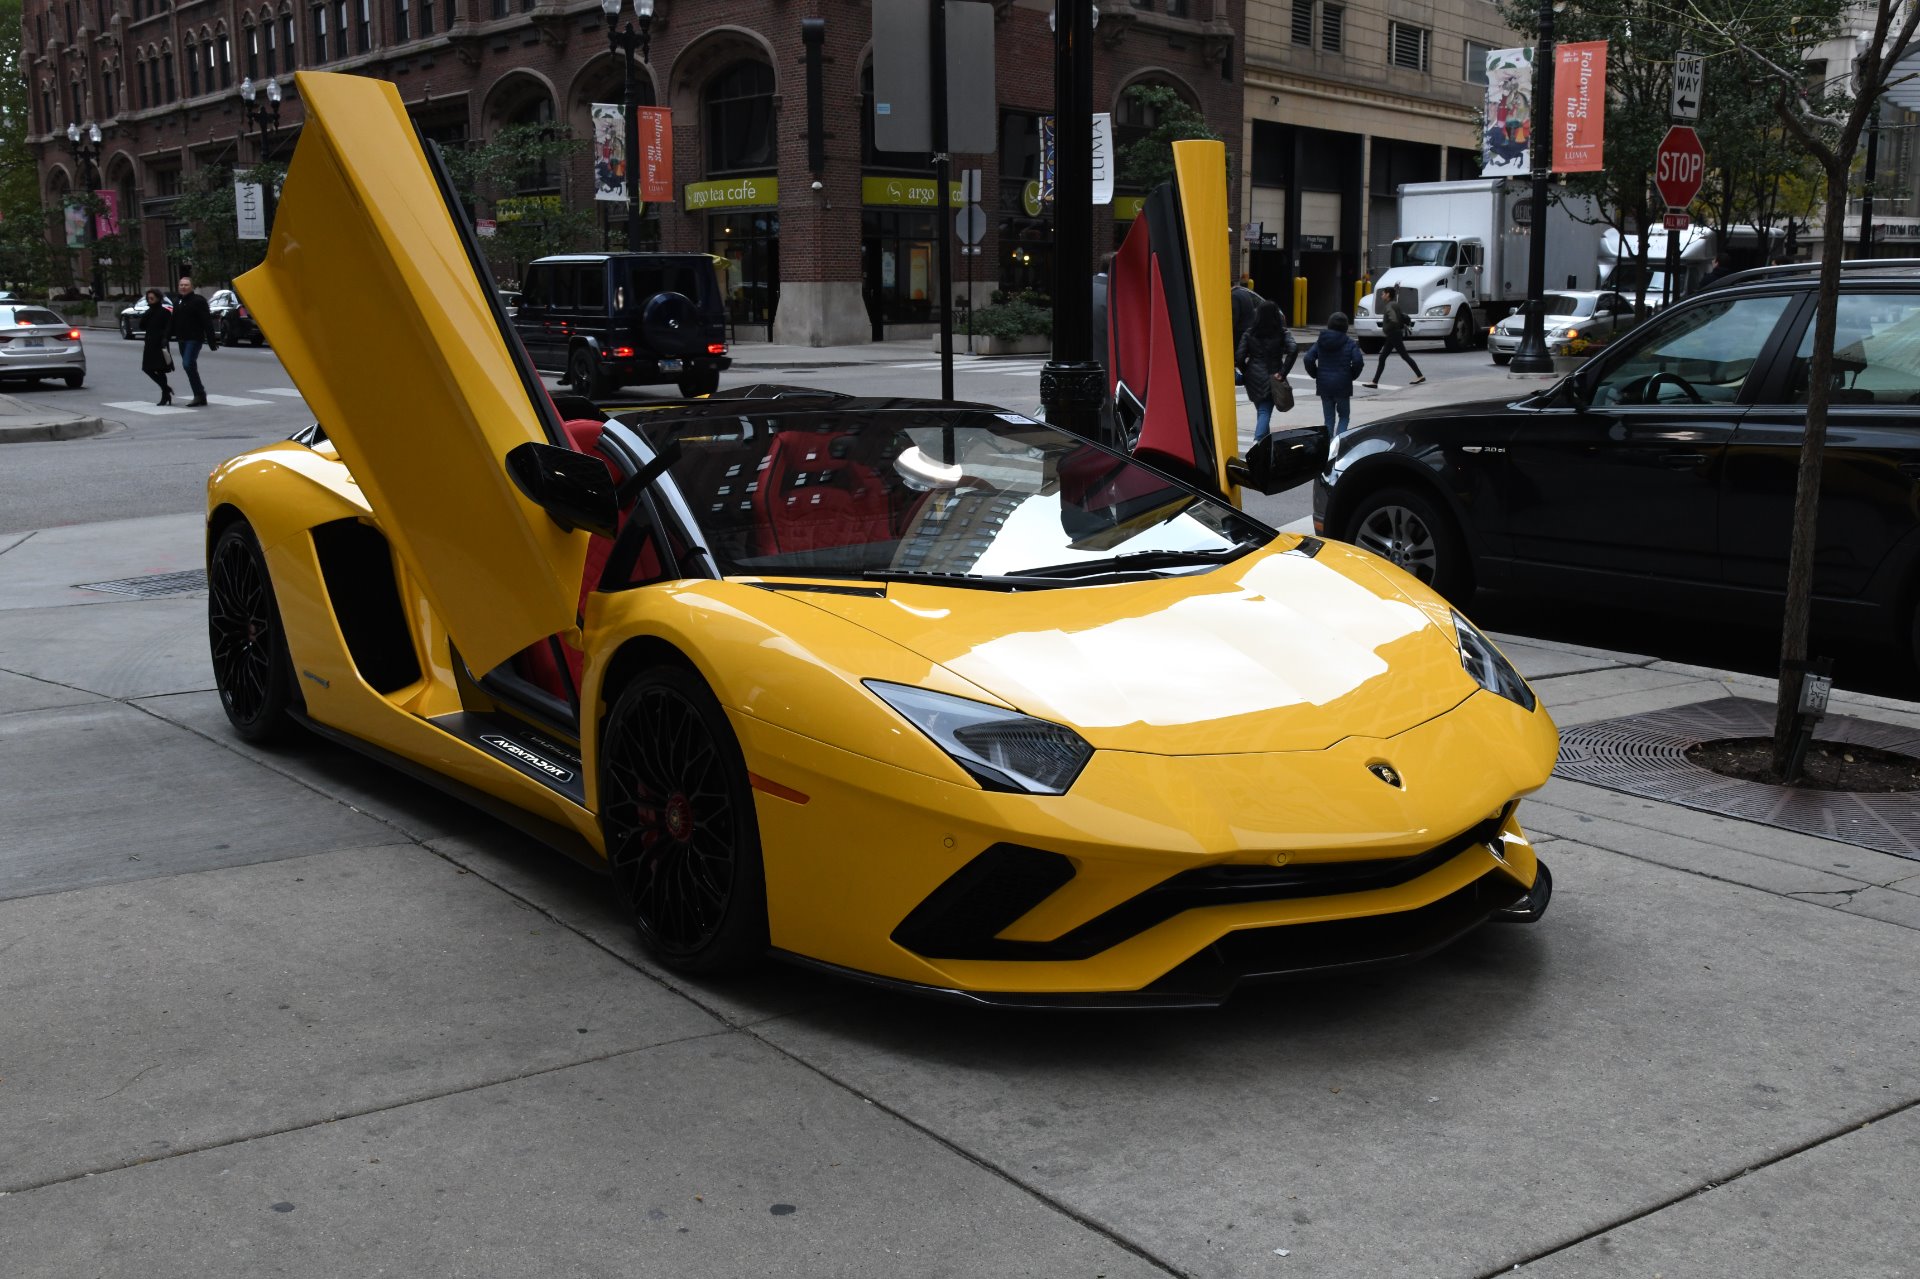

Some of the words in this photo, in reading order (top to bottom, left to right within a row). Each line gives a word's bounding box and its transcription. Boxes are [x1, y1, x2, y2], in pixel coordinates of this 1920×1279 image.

[1679, 57, 1700, 75] ONE
[1576, 51, 1593, 119] Following
[1677, 75, 1700, 93] WAY
[1567, 97, 1579, 118] the
[654, 112, 664, 163] Following
[1566, 122, 1577, 148] Box
[647, 145, 656, 161] the
[1092, 120, 1105, 181] LUMA
[1565, 152, 1588, 160] LUMA
[648, 164, 656, 183] Box
[1659, 151, 1702, 183] STOP
[243, 183, 257, 220] LUM
[693, 190, 709, 207] argo
[710, 187, 724, 201] tea
[727, 180, 756, 200] café
[908, 187, 935, 204] argo
[1666, 218, 1675, 227] ALL
[1677, 218, 1687, 227] WAY
[492, 739, 567, 777] AVENTADOR
